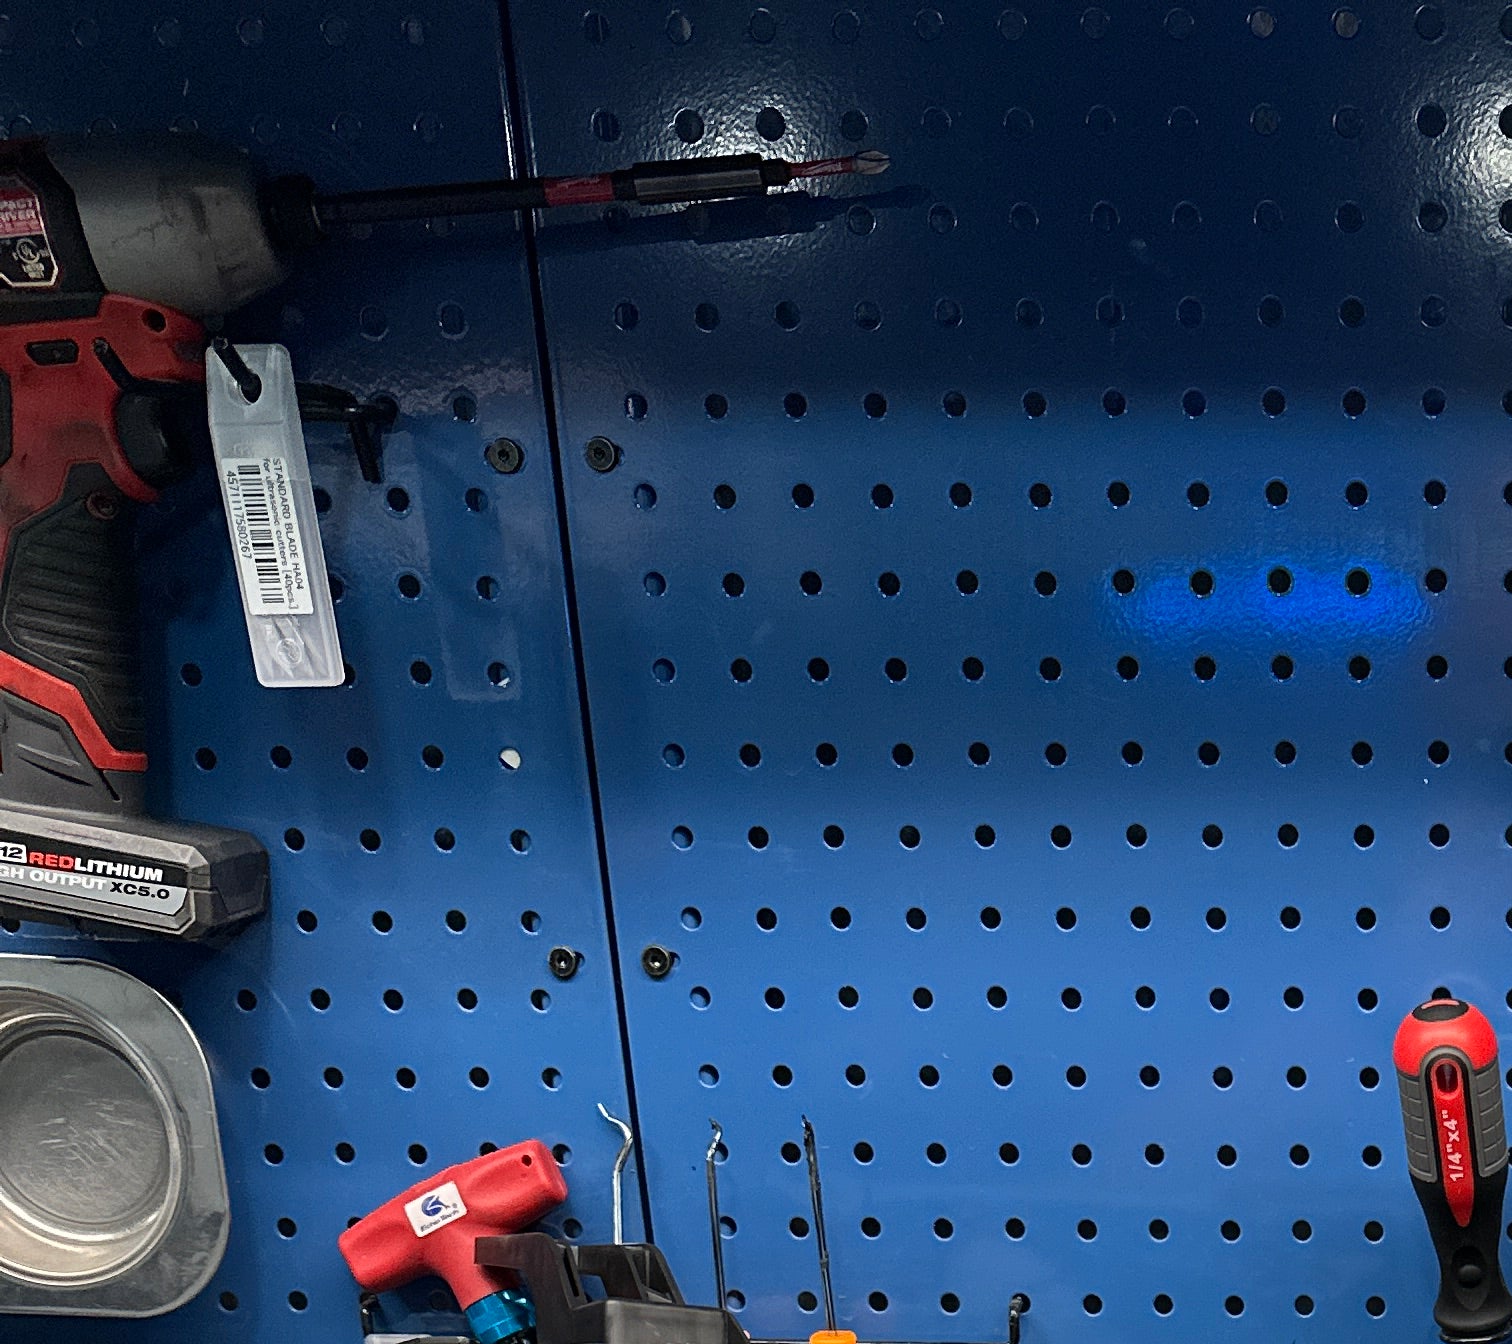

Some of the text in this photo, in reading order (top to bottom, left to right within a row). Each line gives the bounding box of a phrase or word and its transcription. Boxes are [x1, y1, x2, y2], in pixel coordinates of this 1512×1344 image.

[226, 470, 253, 560] 4571117580267
[266, 476, 280, 526] ultrasonic
[276, 530, 288, 566] cutters
[273, 458, 304, 590] STANDARD BLADE HA04
[29, 869, 108, 891] OUTPUT
[110, 881, 170, 900] XC5.0
